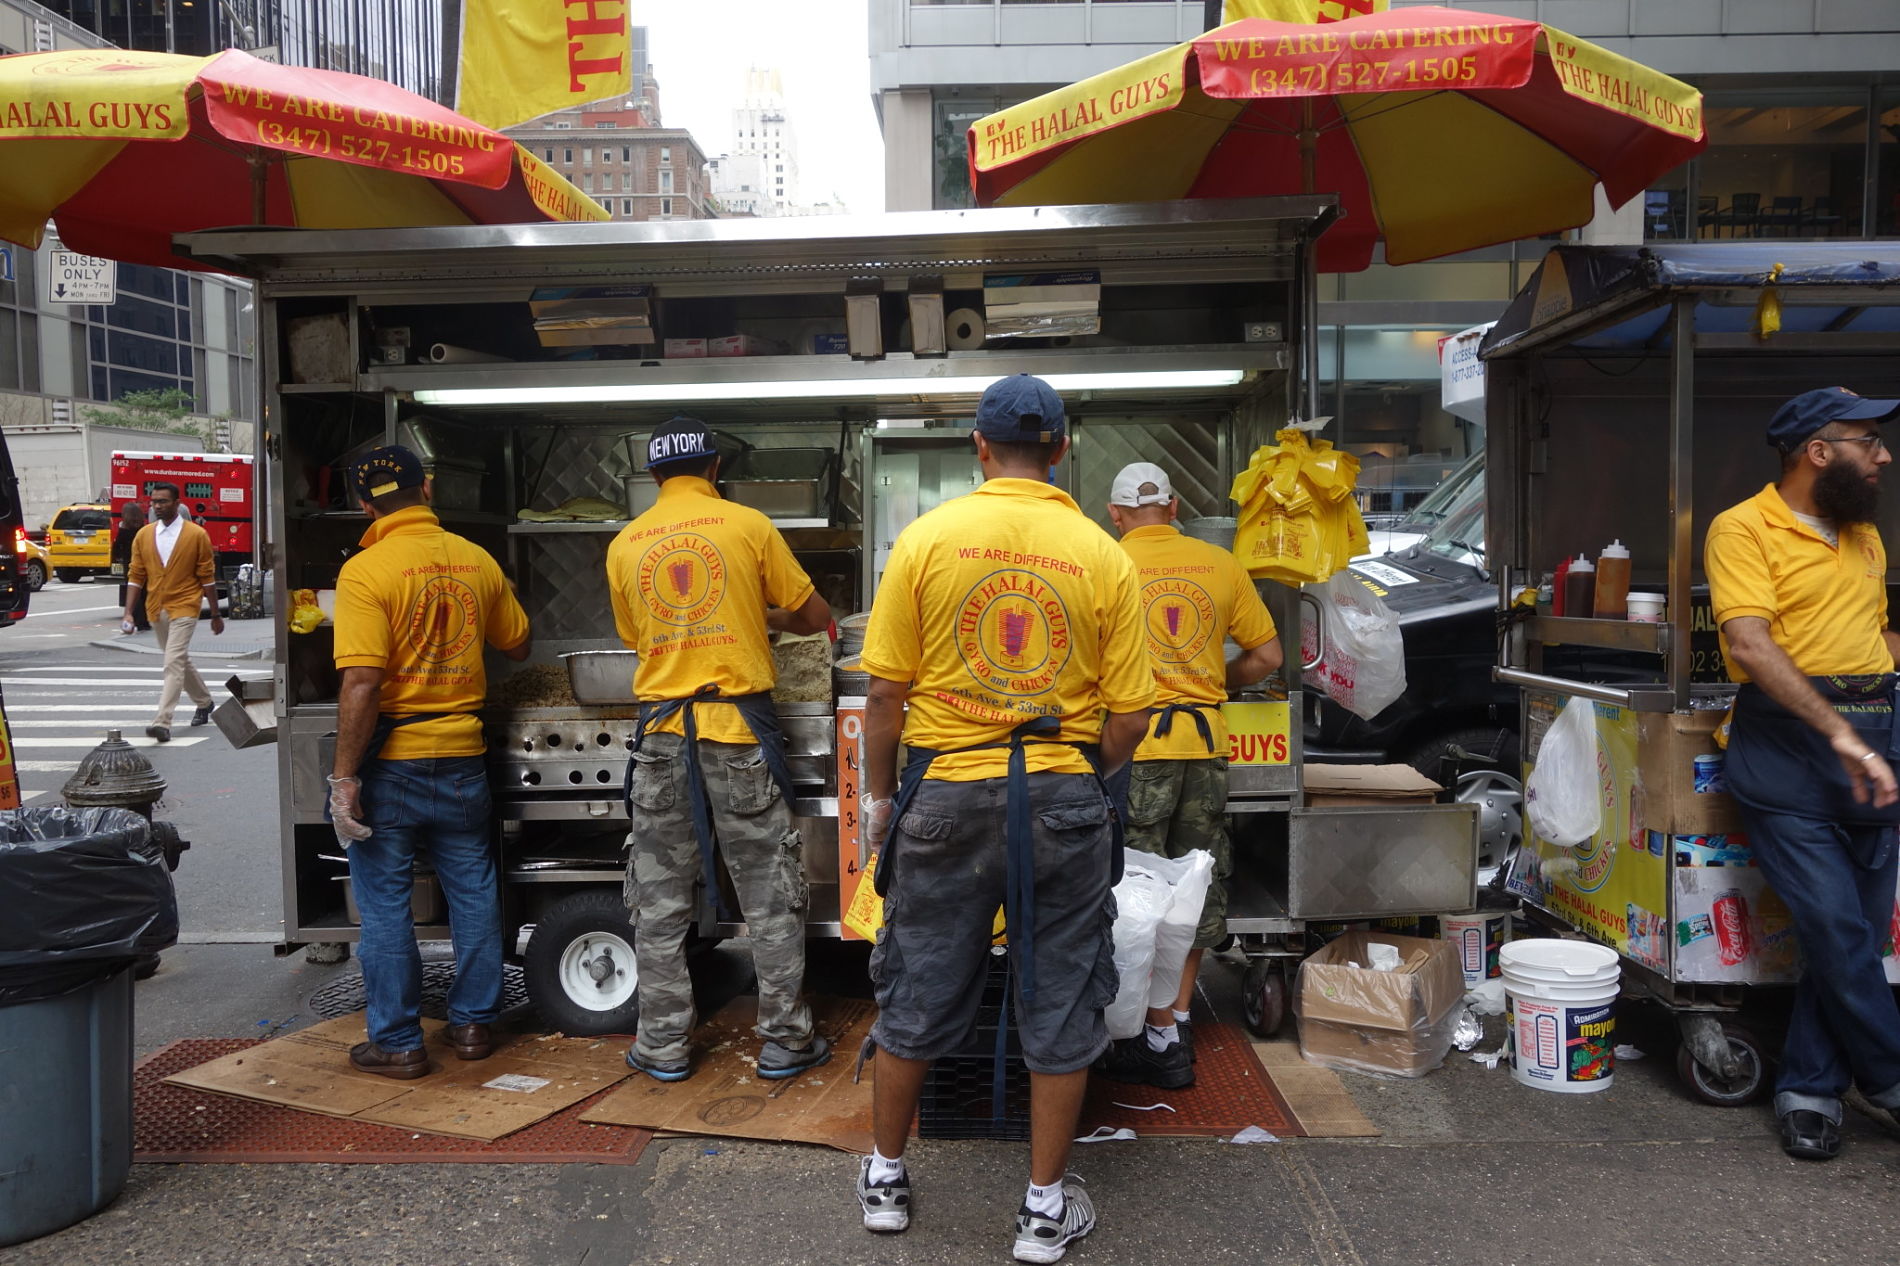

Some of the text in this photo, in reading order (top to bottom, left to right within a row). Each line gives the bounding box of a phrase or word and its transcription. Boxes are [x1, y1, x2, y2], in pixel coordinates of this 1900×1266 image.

[1214, 23, 1514, 61] WE ARE CATERING
[1250, 56, 1477, 93] (347) 527-1505
[1557, 60, 1695, 129] THE HALAL GUYS
[0, 101, 171, 129] ALAL GUYS
[222, 81, 496, 152] WE ARE CATERING
[987, 73, 1170, 160] THE HALAL GUYS
[257, 119, 465, 175] (347) 527-1505
[523, 171, 546, 204] THE
[59, 255, 107, 266] BUSES
[64, 268, 101, 280] ONLY
[650, 433, 705, 461] NEW YORK
[629, 517, 725, 543] WE ARE DIFFERENT
[641, 537, 722, 594] THE HALAL GUYS
[959, 547, 1085, 578] WE ARE DIFFERENT
[1140, 566, 1215, 576] ARE DIFFERENT
[461, 592, 477, 625] GUYS
[960, 576, 1067, 649] THE HALAL GUYS
[653, 634, 669, 644] 6th
[965, 642, 1058, 690] GYRO and CHICKEN
[1331, 671, 1354, 689] YOU
[1005, 700, 1014, 710] &
[1017, 700, 1047, 715] 53rd
[1228, 733, 1287, 762] GUYS
[1596, 752, 1615, 808] GUYS
[1554, 885, 1626, 933] THE HALAL GUYS
[1586, 923, 1600, 938] 6th
